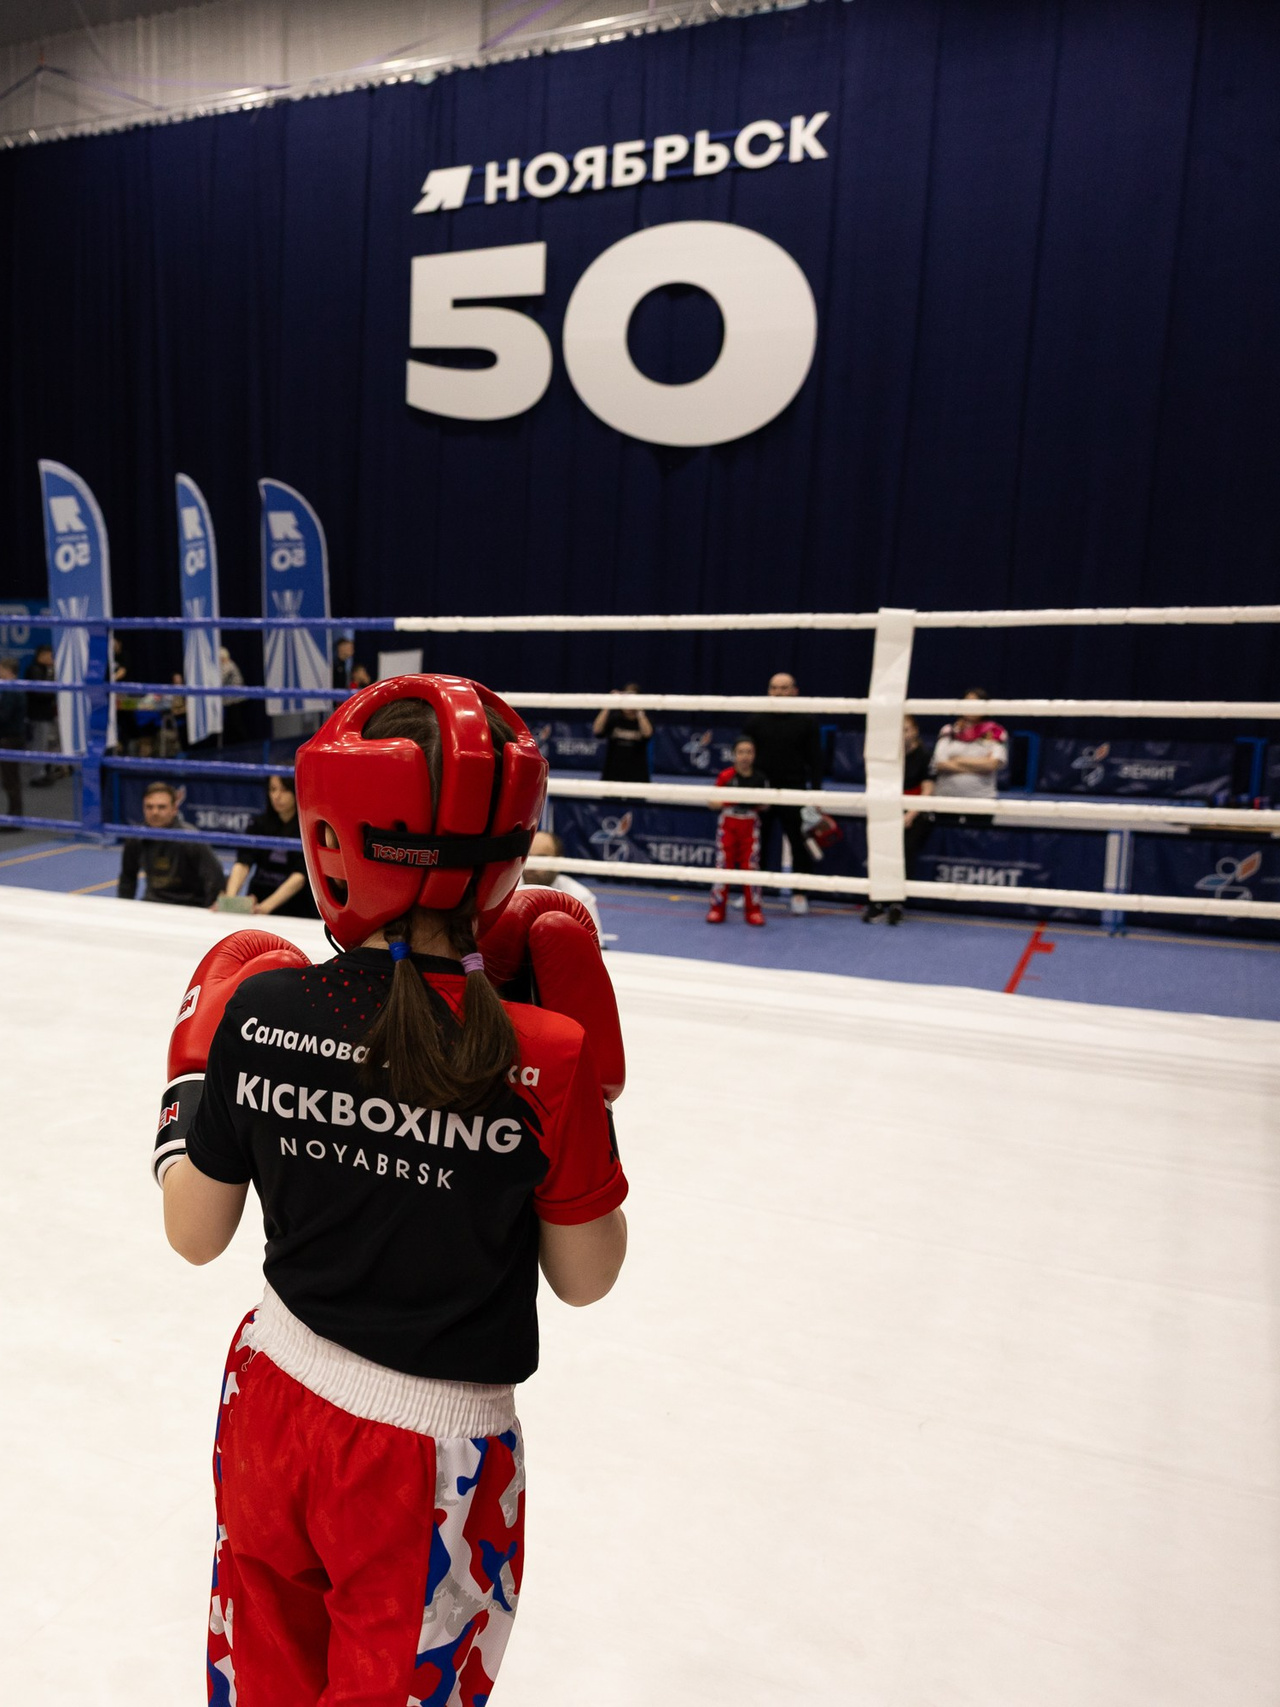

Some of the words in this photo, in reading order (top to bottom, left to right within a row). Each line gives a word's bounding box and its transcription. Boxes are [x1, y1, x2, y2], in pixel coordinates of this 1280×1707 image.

[484, 111, 831, 205] НОЯБРЬСК
[405, 219, 818, 448] 50
[935, 863, 1023, 888] ЗЕНИТ
[240, 1016, 370, 1064] Саламова
[236, 1071, 523, 1154] KICKBOXING
[280, 1136, 455, 1190] NOYABRSK
